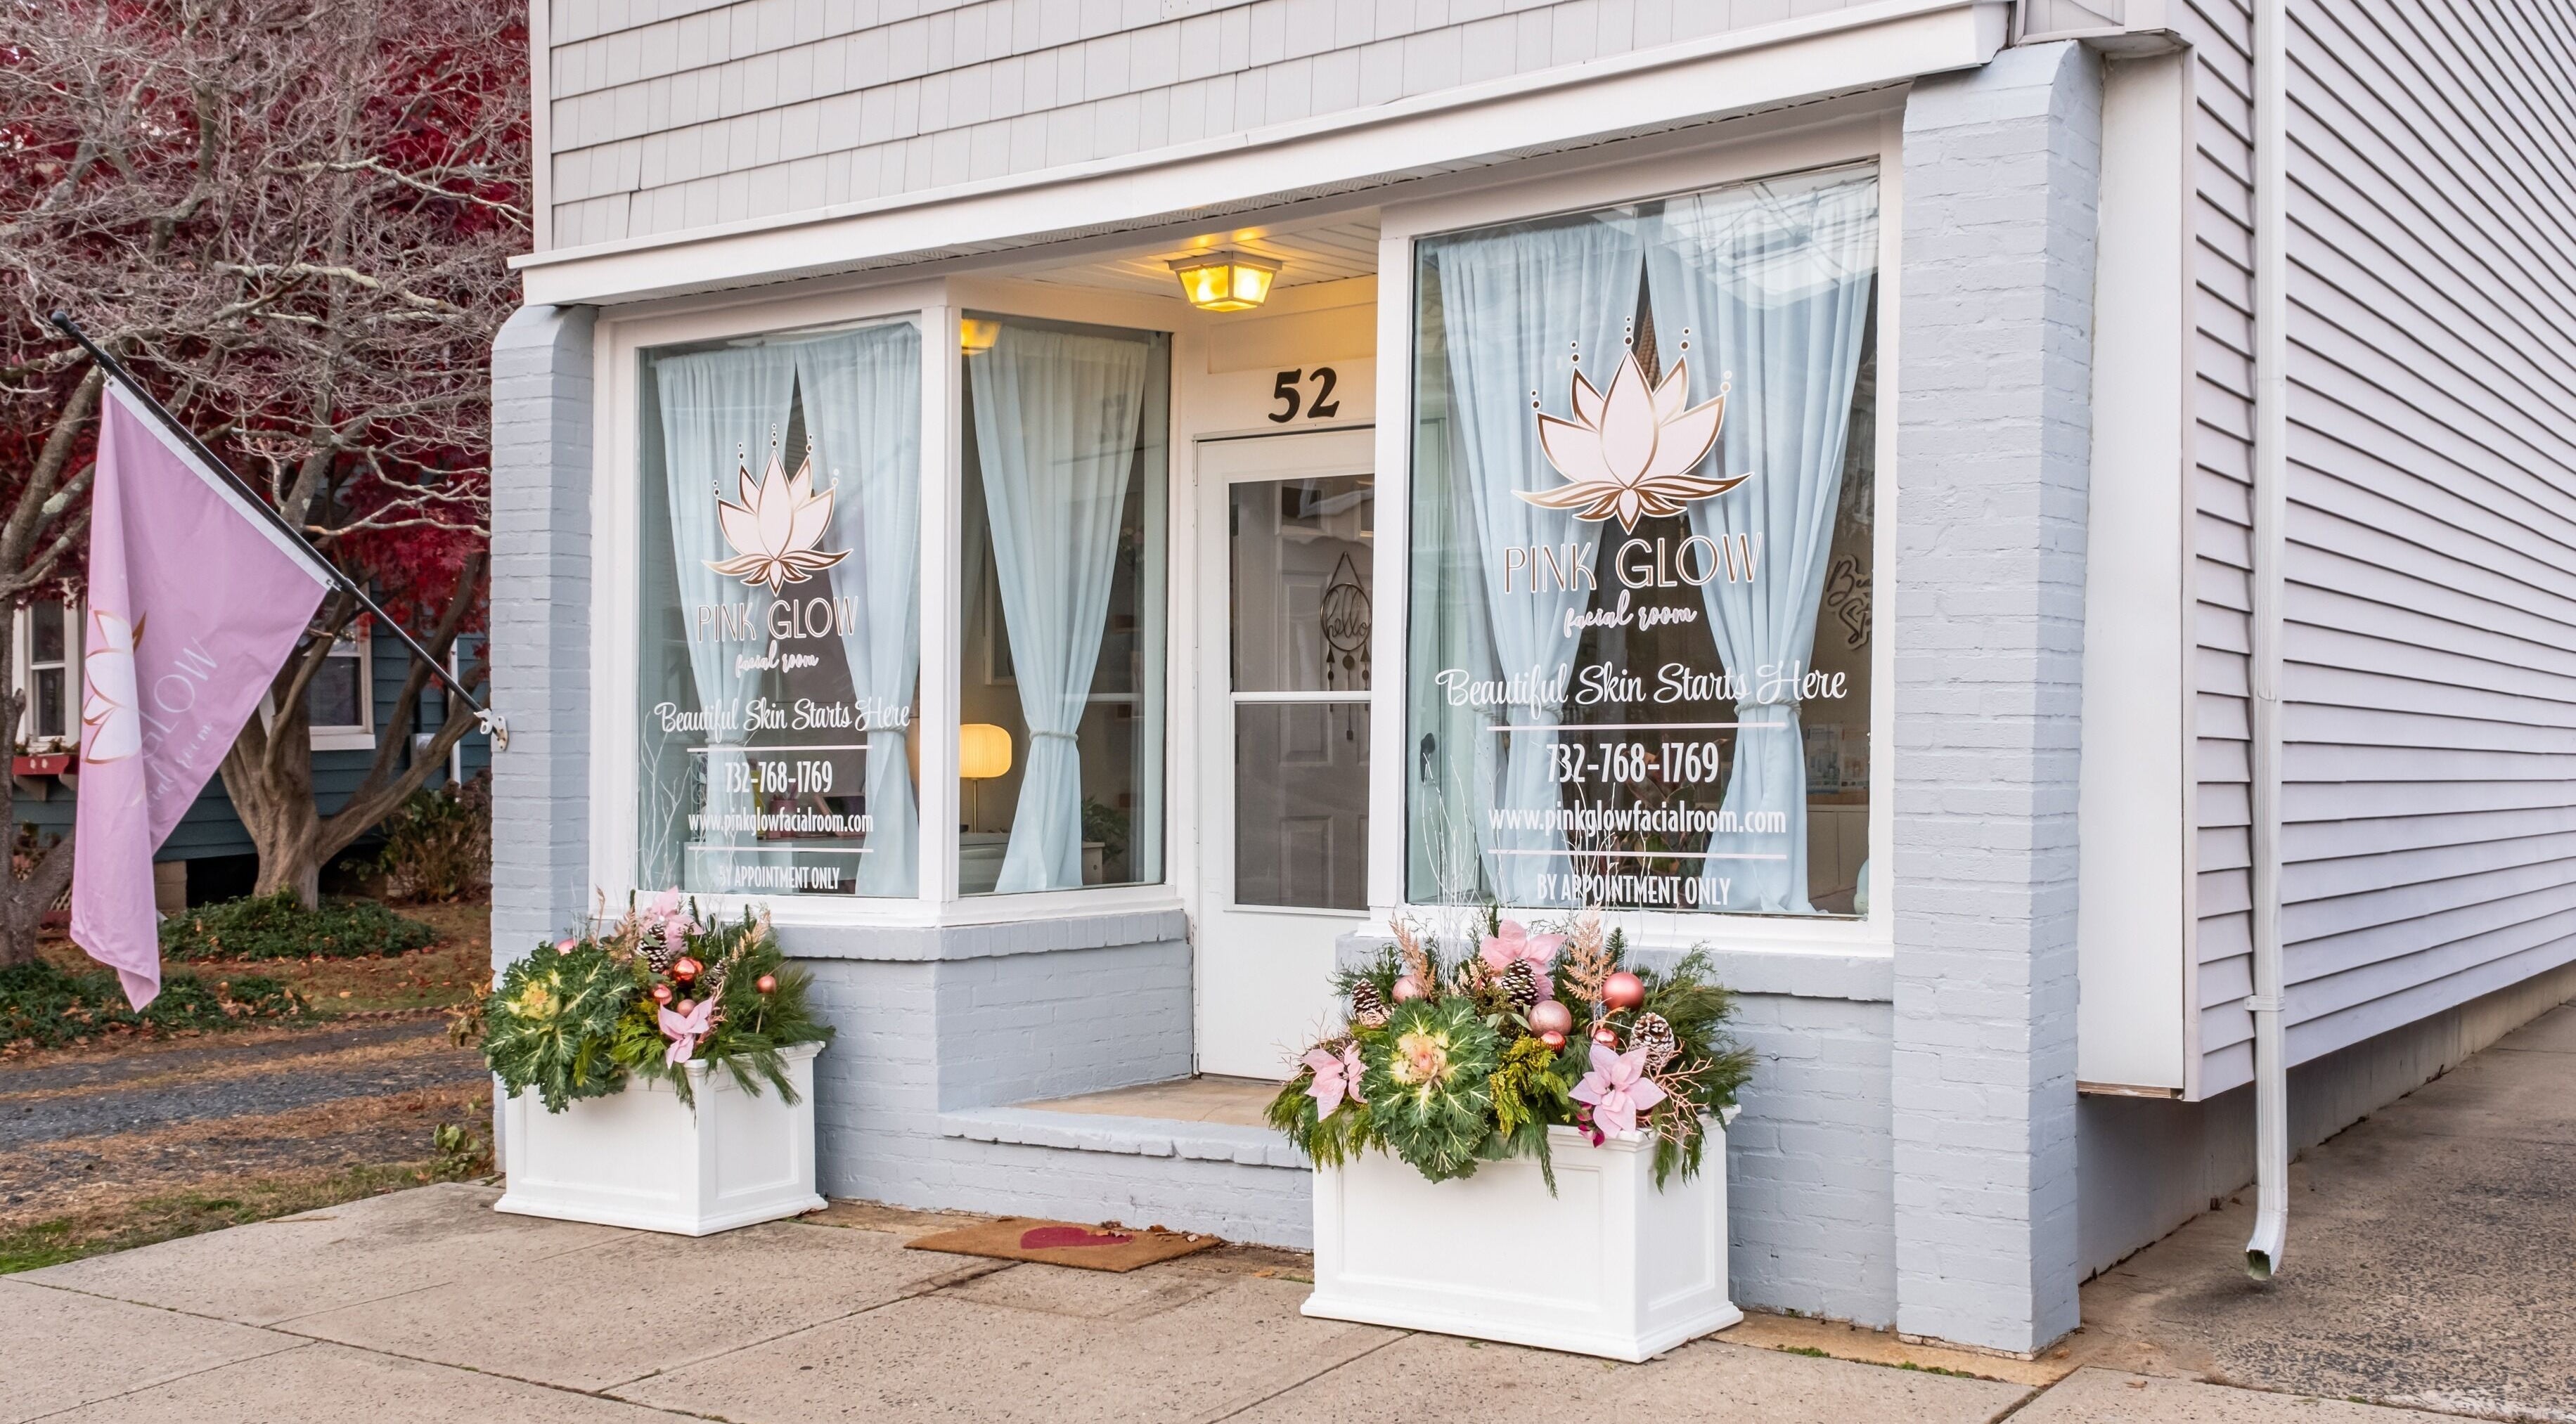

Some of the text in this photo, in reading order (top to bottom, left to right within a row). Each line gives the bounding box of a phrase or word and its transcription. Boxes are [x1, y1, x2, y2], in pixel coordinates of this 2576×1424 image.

[1268, 366, 1340, 423] 52
[1505, 532, 1761, 595] PINK GLOW
[697, 595, 858, 643] PINK GLOW
[1564, 589, 1697, 637] facial room
[735, 640, 819, 678] facial room
[1435, 660, 1847, 720] Beautiful Skin Starts Here
[654, 697, 910, 743] Beautiful Skin Starts Here
[726, 760, 832, 794] 732-768-1769
[1546, 742, 1718, 784] 732-768-1769
[688, 807, 874, 836] www.pinkglowfacialroom.com
[1488, 800, 1786, 837] www.pinkglowfacialroom.com
[734, 865, 809, 889] APPOINTMENT
[811, 866, 840, 890] ONLY
[1537, 874, 1731, 905] BY APPOINTMENT ONLY
